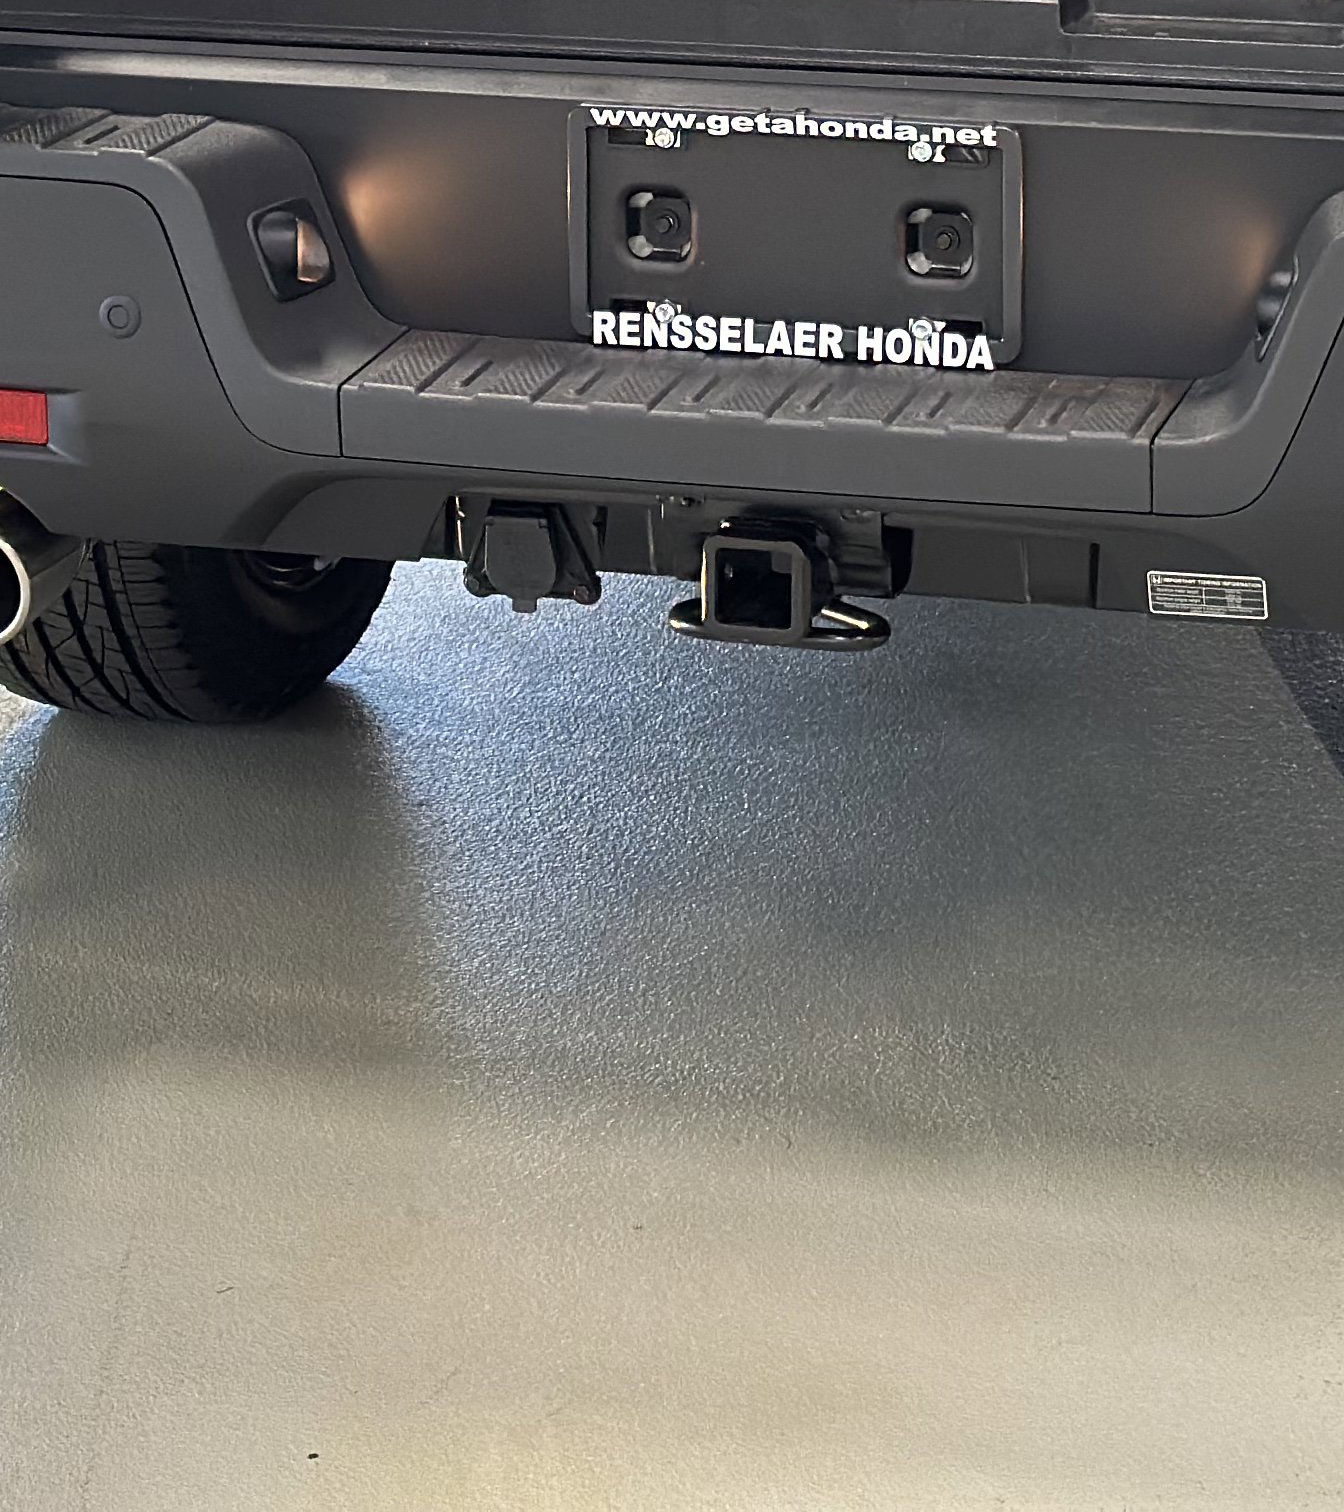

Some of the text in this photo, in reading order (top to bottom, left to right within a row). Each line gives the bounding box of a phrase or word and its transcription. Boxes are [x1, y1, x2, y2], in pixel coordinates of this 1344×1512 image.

[590, 108, 997, 147] www.getahonda.net
[592, 310, 994, 370] RENSSELAER HONDA
